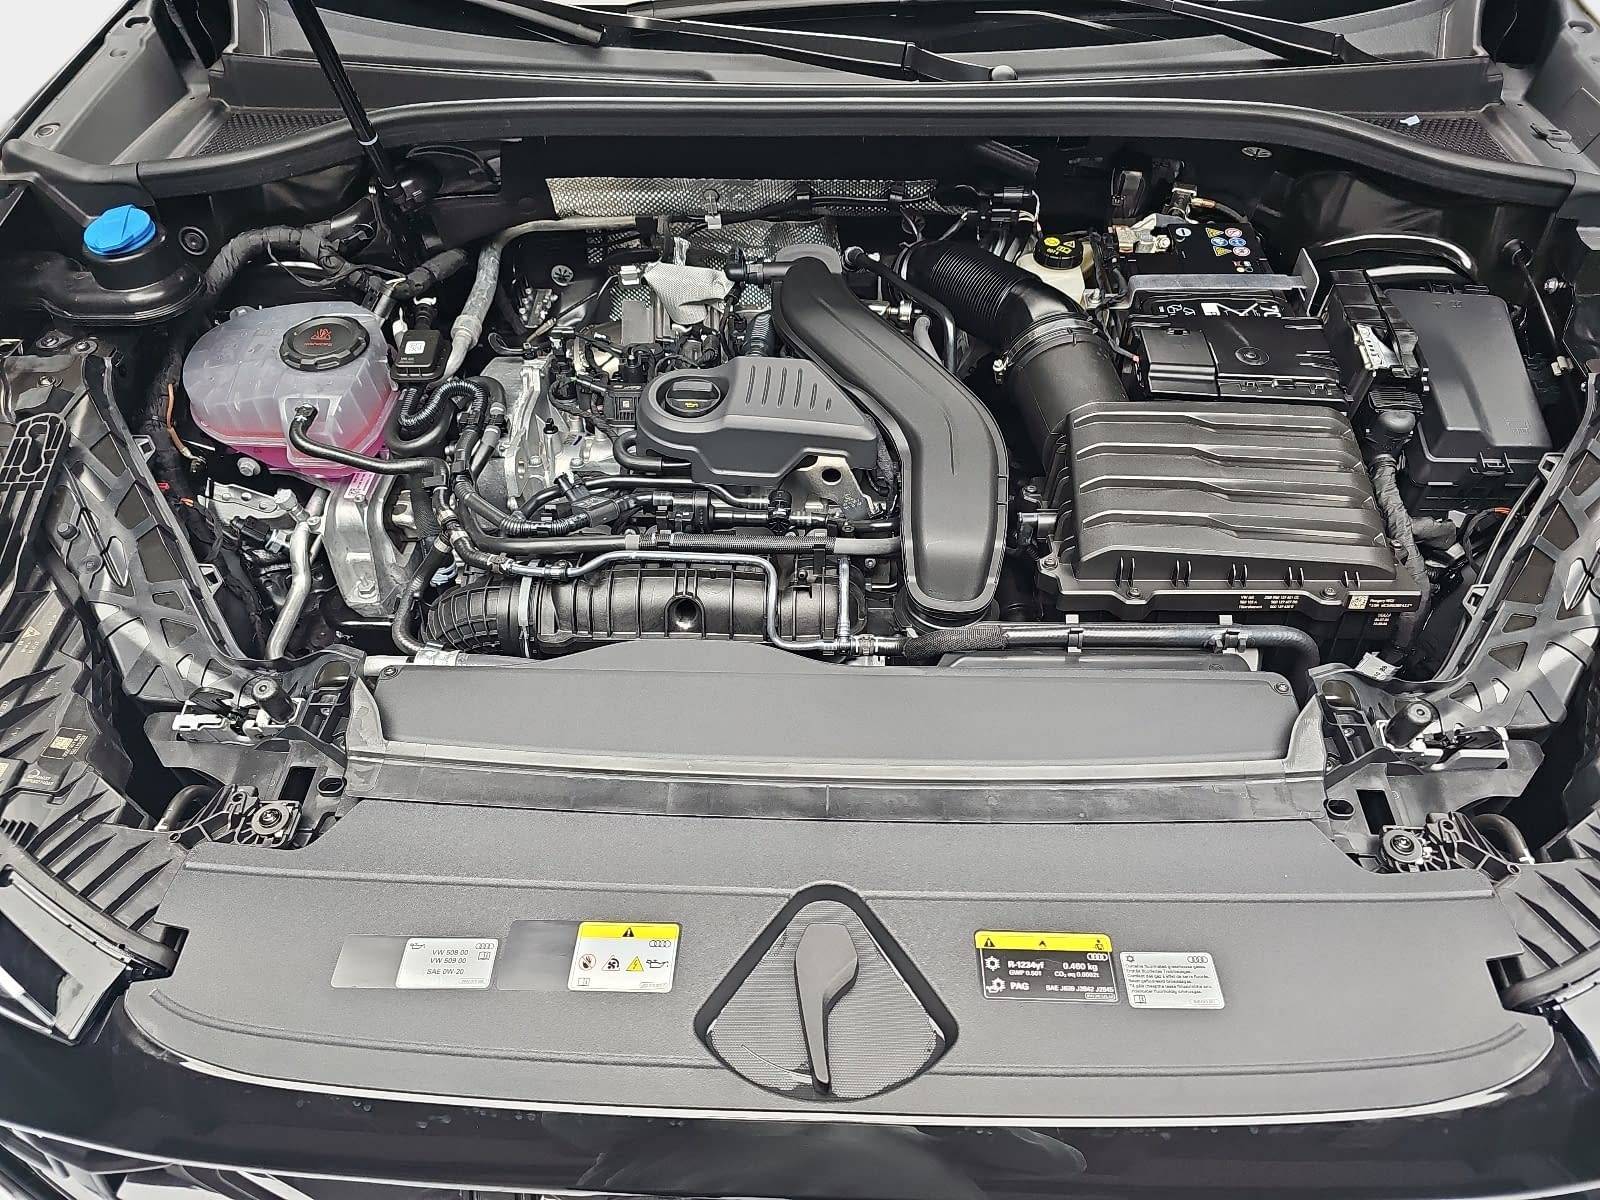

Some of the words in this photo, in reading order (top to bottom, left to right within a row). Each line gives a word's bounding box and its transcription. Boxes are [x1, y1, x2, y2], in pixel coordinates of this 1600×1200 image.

[1007, 960, 1045, 970] R-1234yf
[1087, 962, 1098, 972] kg
[1010, 981, 1030, 991] PAG
